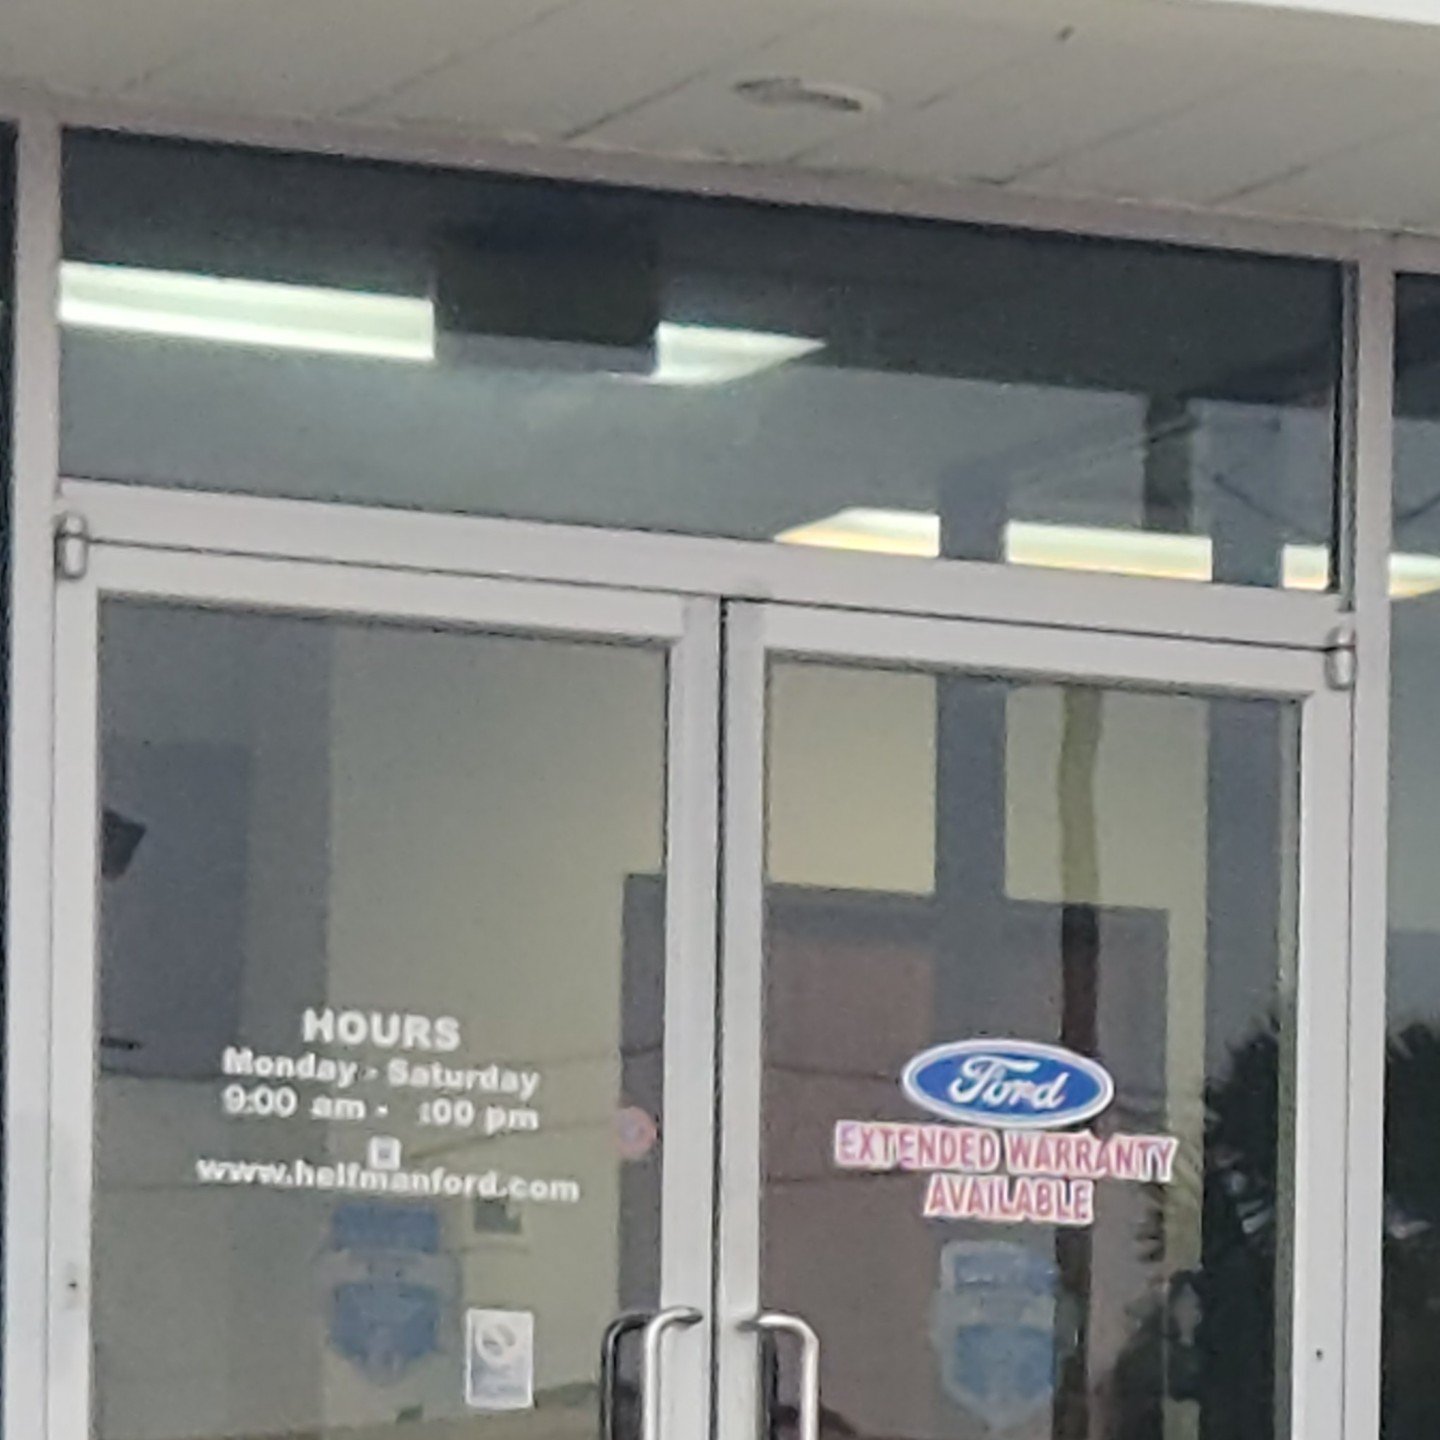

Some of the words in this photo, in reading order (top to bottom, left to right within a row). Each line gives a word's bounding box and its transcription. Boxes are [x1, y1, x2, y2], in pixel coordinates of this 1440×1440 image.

[303, 1006, 461, 1052] HOURS
[222, 1046, 358, 1088] Monday
[387, 1057, 541, 1100] Saturday
[949, 1054, 1069, 1109] Ford
[221, 1084, 298, 1118] 9:00
[311, 1096, 367, 1121] am
[484, 1105, 540, 1135] pm
[837, 1123, 998, 1171] EXTENDED
[1005, 1131, 1176, 1182] WARRANTY
[196, 1159, 581, 1202] www.helfmanford.com
[924, 1175, 1093, 1223] AVAILABLE
